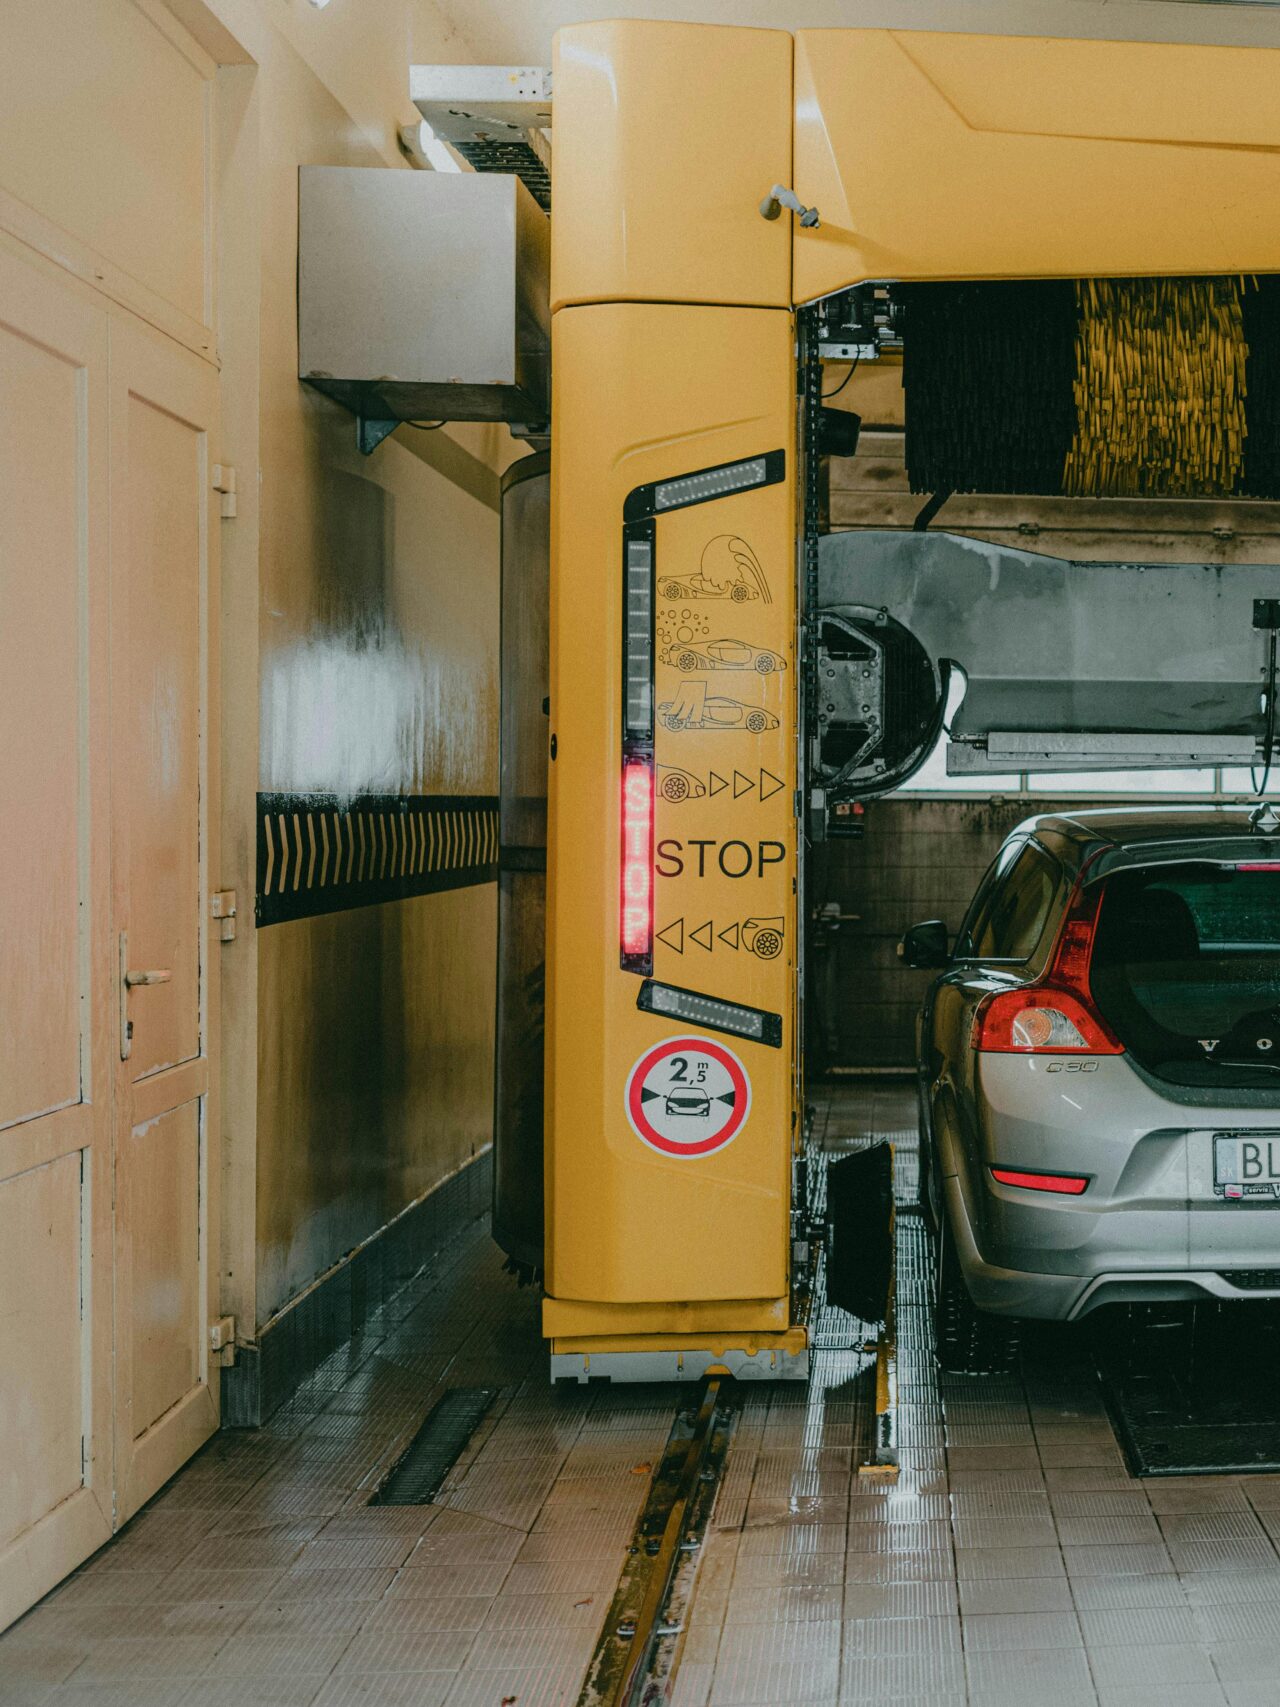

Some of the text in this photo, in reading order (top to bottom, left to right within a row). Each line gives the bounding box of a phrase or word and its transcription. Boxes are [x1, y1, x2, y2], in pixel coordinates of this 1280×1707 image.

[625, 776, 650, 944] STOP
[655, 839, 786, 878] STOP
[1046, 1061, 1099, 1073] C30
